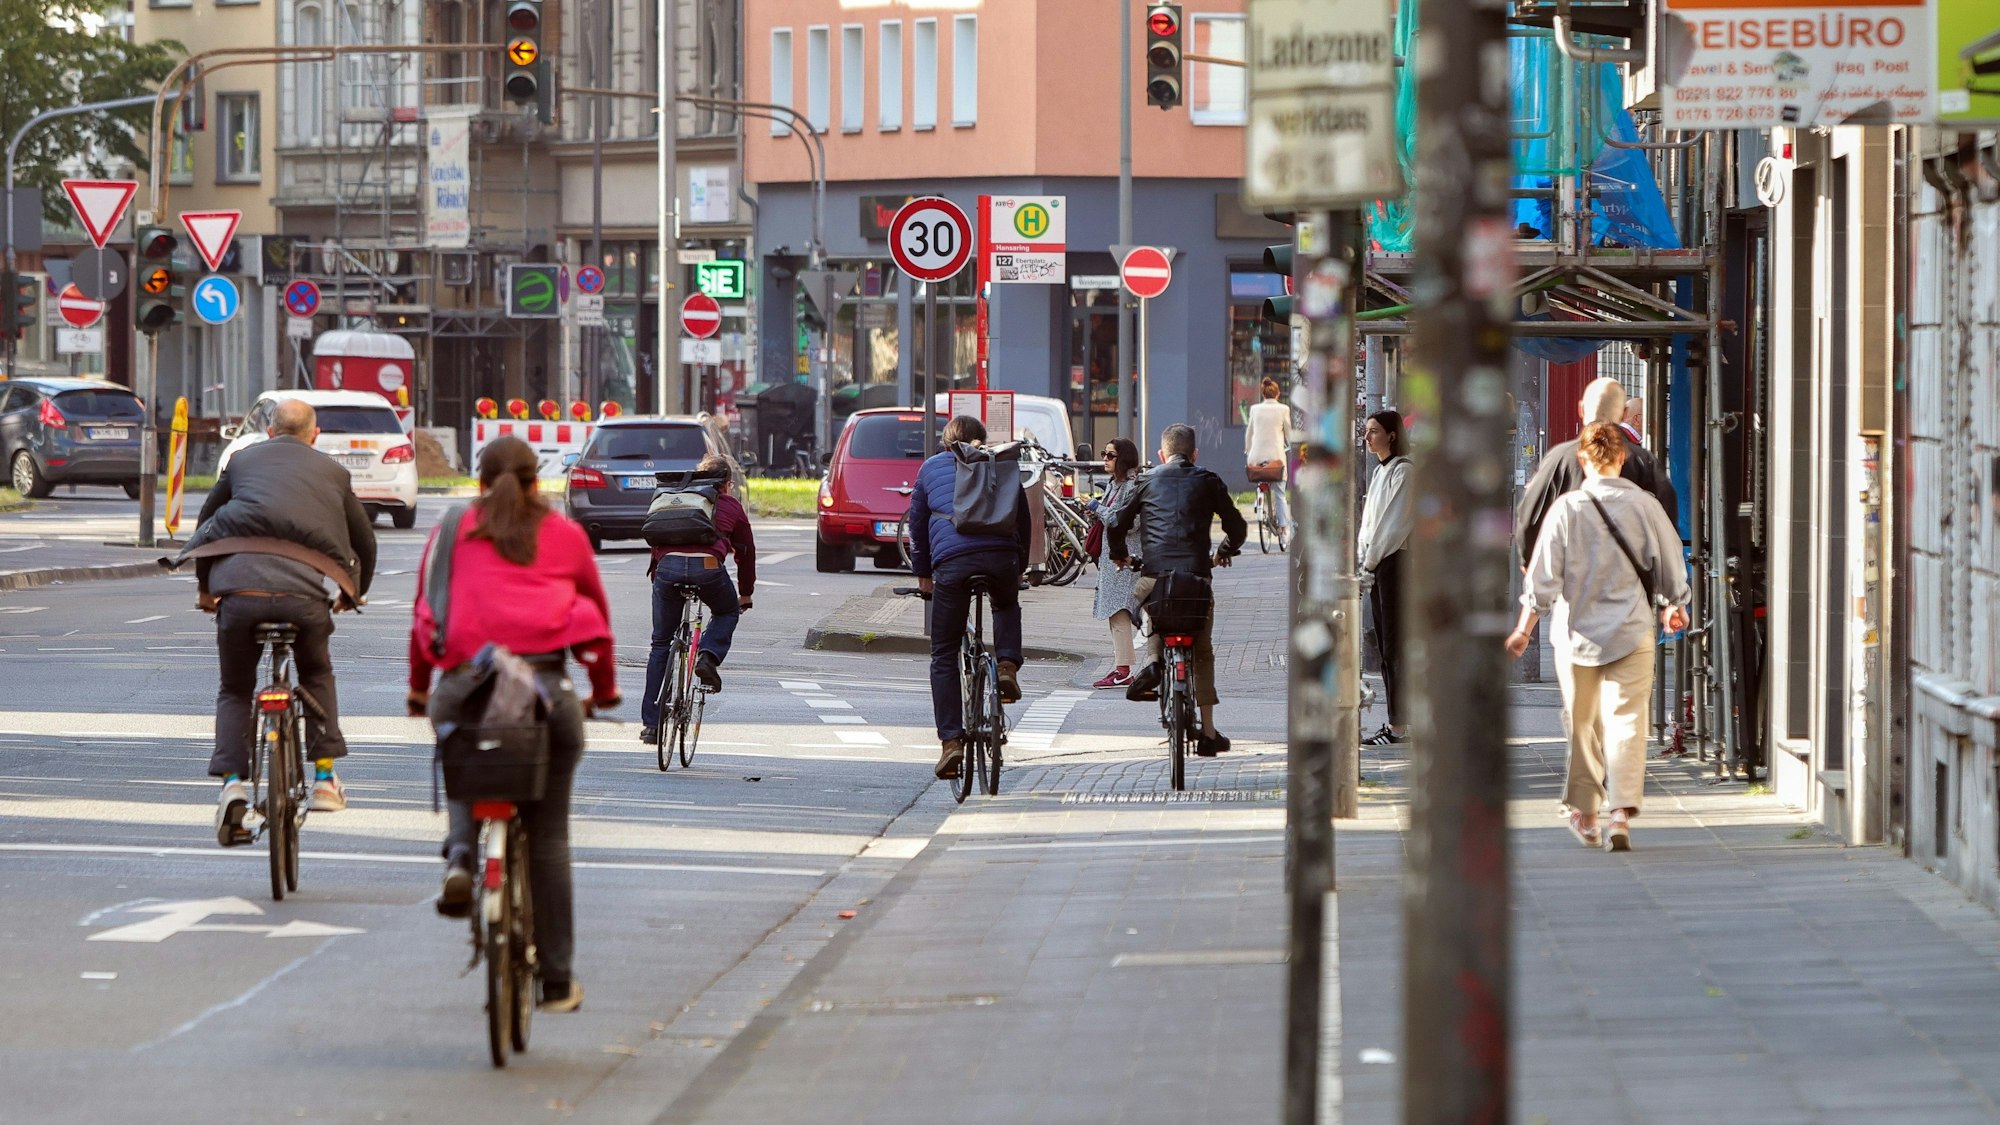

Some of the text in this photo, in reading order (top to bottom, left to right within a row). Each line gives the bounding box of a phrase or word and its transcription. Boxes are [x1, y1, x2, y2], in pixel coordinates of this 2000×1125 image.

[1254, 22, 1388, 70] Ladezone
[1727, 61, 1737, 76] &
[1835, 60, 1910, 76] Iraq Post
[1024, 210, 1040, 231] H
[908, 221, 953, 257] 30
[996, 244, 1030, 253] Hansaring
[998, 256, 1046, 266] 127 Ebertplatz
